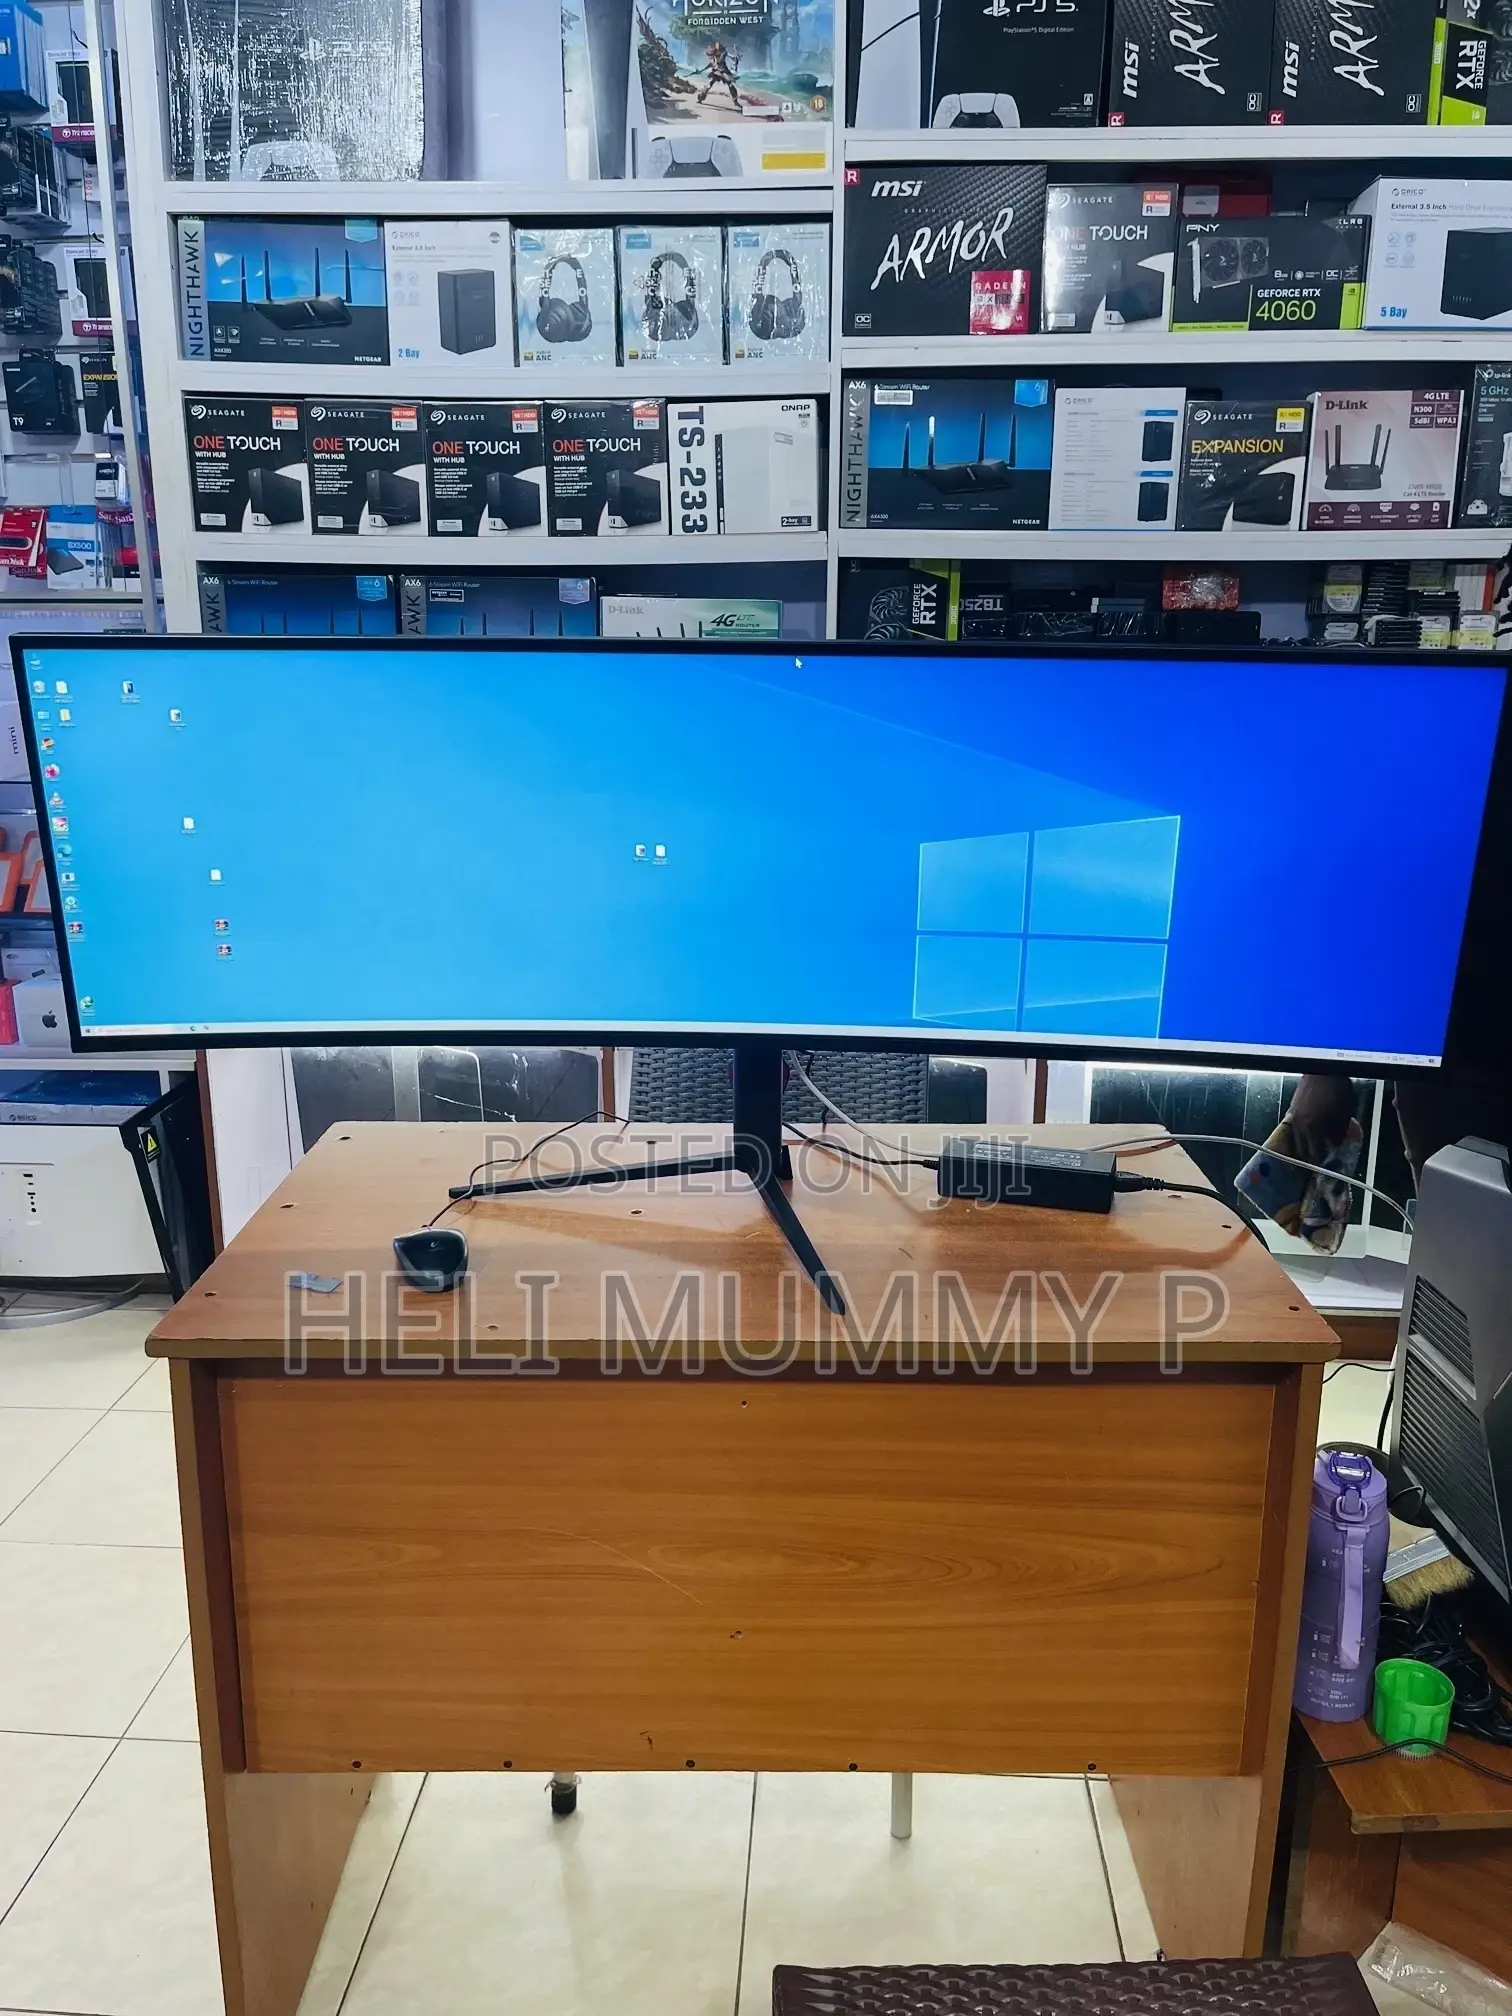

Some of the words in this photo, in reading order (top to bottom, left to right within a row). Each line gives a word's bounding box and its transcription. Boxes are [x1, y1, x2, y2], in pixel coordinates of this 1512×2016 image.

[687, 17, 737, 26] FORBIDDEN
[738, 15, 764, 24] WEST
[1168, 0, 1227, 95] ARM
[1328, 0, 1385, 96] ARM
[1123, 40, 1140, 98] msi
[1282, 40, 1300, 98] msi
[1456, 40, 1478, 90] RTX
[1474, 40, 1487, 90] GEFORCE
[1248, 93, 1257, 110] OC
[1408, 95, 1416, 111] OC
[1111, 114, 1122, 126] R
[1271, 112, 1282, 125] R
[847, 171, 858, 183] R
[871, 181, 923, 197] msi
[1052, 226, 1085, 240] ONE
[1089, 225, 1149, 241] TOUCH
[1186, 223, 1220, 232] PNY
[870, 207, 1014, 290] ARMOR
[184, 230, 205, 356] NIGHTHAWK
[975, 282, 1027, 290] RADEN
[1257, 289, 1300, 298] GEFORCE
[1302, 288, 1321, 297] RTX
[1256, 300, 1316, 321] 4060
[1380, 306, 1387, 318] 5
[1390, 306, 1407, 319] Bay
[354, 355, 382, 363] NETGEAR
[398, 348, 404, 358] 2
[405, 348, 420, 359] Bay
[848, 380, 867, 389] AX6
[1488, 386, 1510, 395] GHz
[1424, 392, 1434, 400] 4G
[1325, 400, 1368, 410] D-Link
[13, 416, 24, 426] T9
[193, 436, 225, 449] ONE
[226, 436, 281, 451] TOUCH
[312, 437, 344, 451] ONE
[346, 438, 400, 452] TOUCH
[432, 441, 464, 455] ONE
[466, 440, 520, 455] TOUCH
[552, 439, 585, 453] ONE
[586, 438, 641, 452] TOUCH
[1191, 438, 1284, 454] EXPANSION
[846, 397, 865, 523] NIGHTHAWK
[677, 405, 708, 534] TS-233
[0, 558, 25, 566] anDisk
[203, 577, 219, 585] AX6
[404, 578, 421, 587] AX6
[608, 605, 644, 614] D-Link
[912, 584, 921, 624] GEFORCE
[920, 584, 937, 624] RTX
[711, 613, 737, 627] 4G
[8, 726, 19, 755] mini
